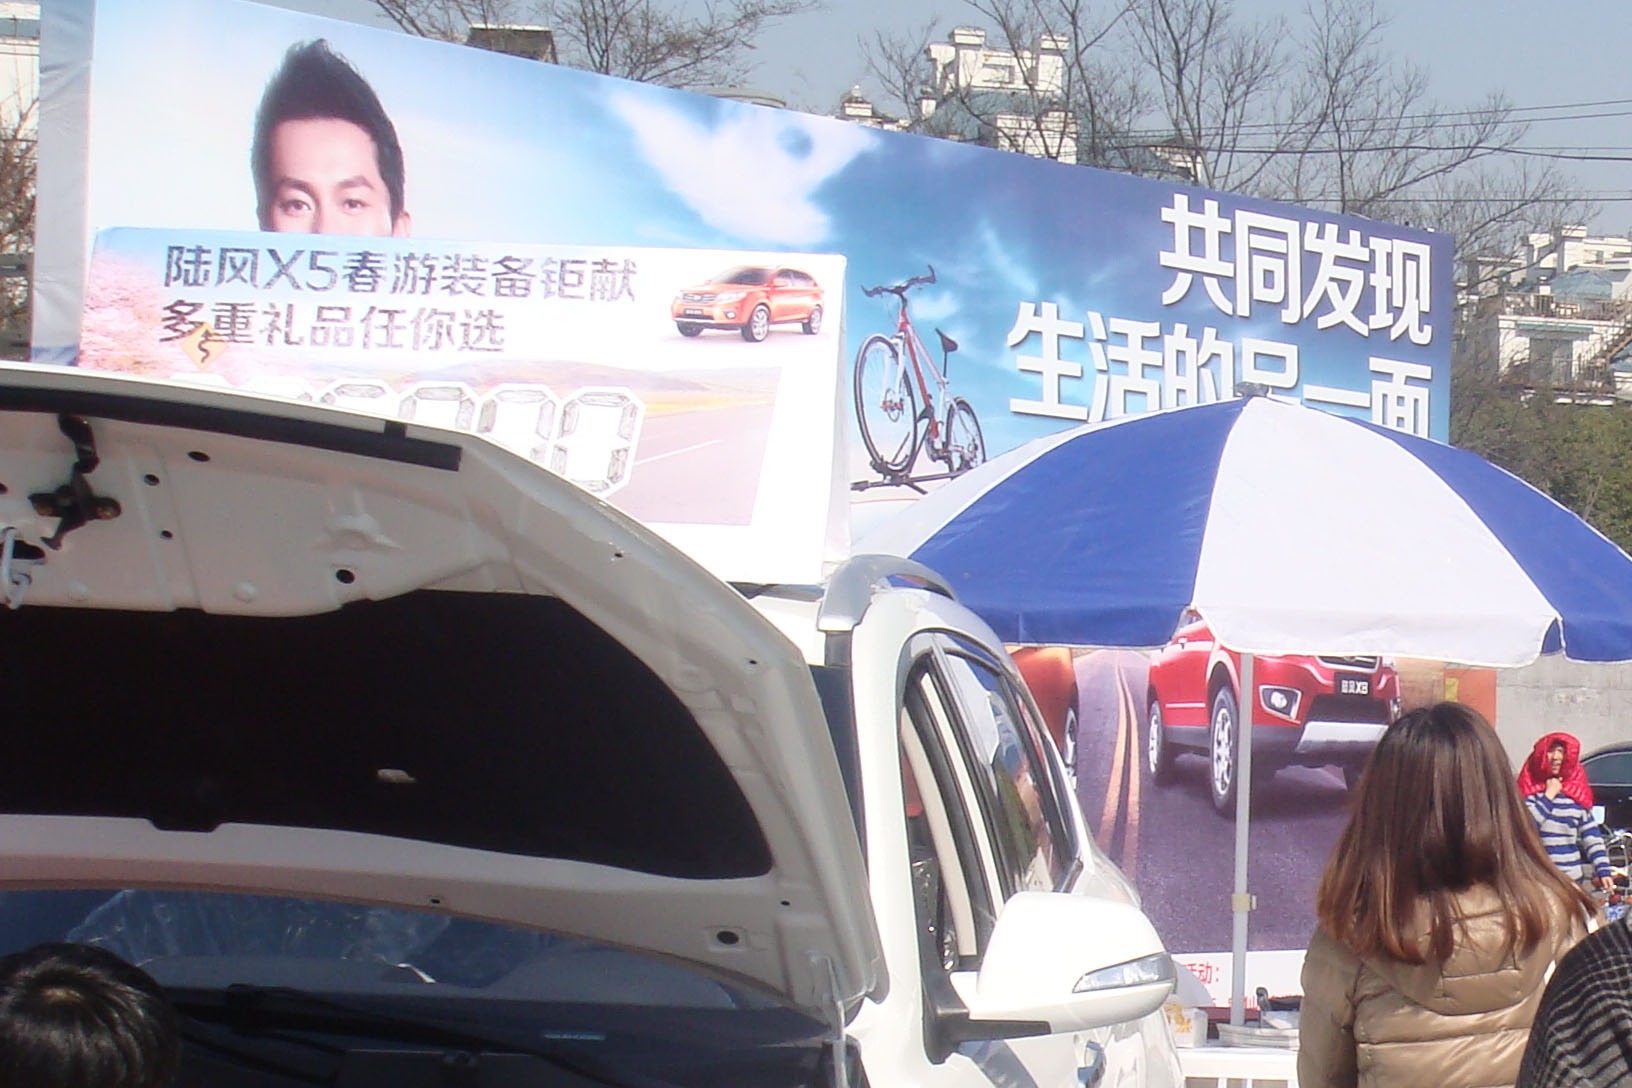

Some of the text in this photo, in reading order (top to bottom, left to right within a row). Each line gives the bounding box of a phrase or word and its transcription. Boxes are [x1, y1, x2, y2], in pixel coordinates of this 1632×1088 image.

[165, 243, 638, 302] 陆风X5春游装备钜献
[1159, 192, 1433, 346] 共同发现
[159, 299, 507, 353] 多重礼品任你选
